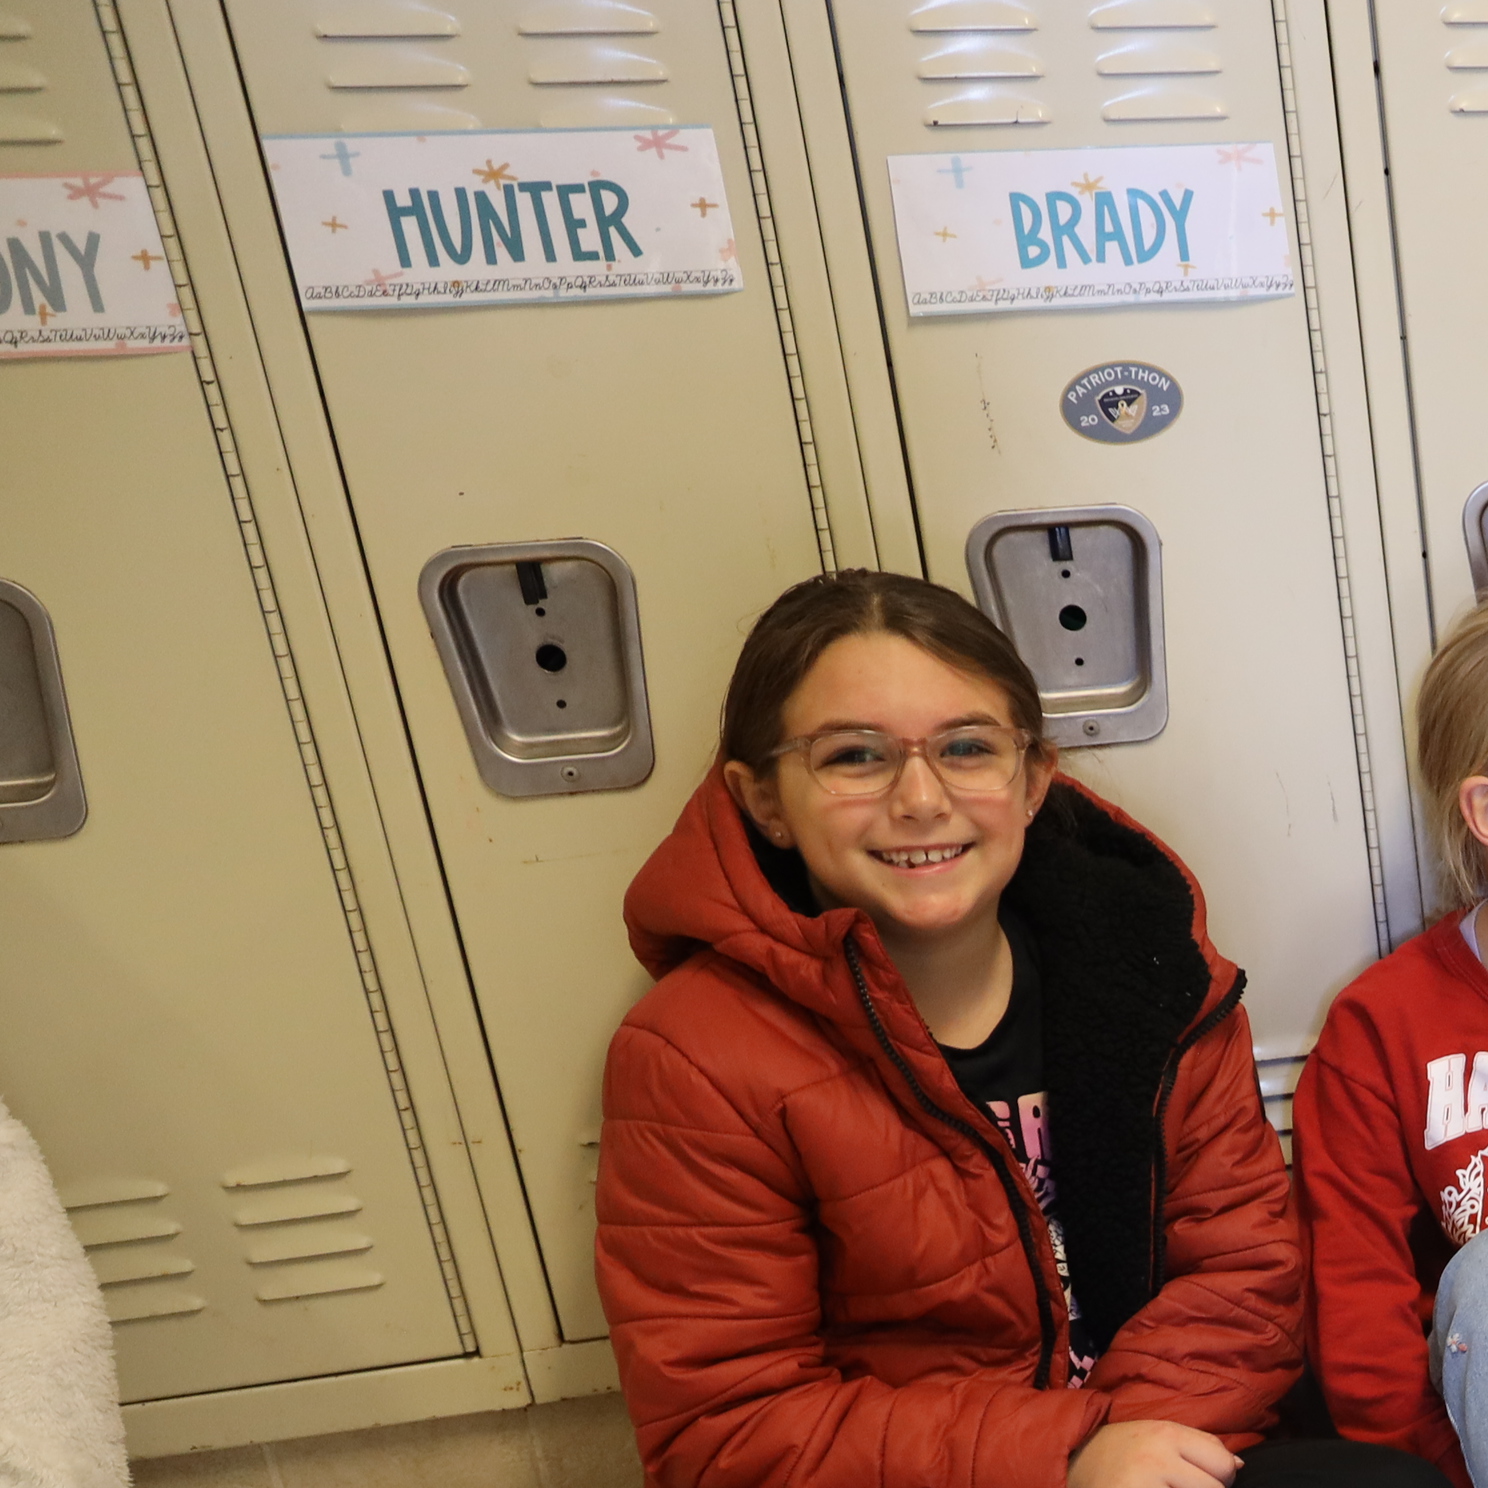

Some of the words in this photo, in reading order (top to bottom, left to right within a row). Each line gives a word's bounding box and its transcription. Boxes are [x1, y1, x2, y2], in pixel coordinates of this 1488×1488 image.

[382, 180, 644, 268] HUNTER
[1009, 188, 1194, 269] BRADY
[1067, 367, 1171, 404] PATRIOT-THON
[1080, 415, 1098, 427] 20
[1152, 404, 1170, 416] 23
